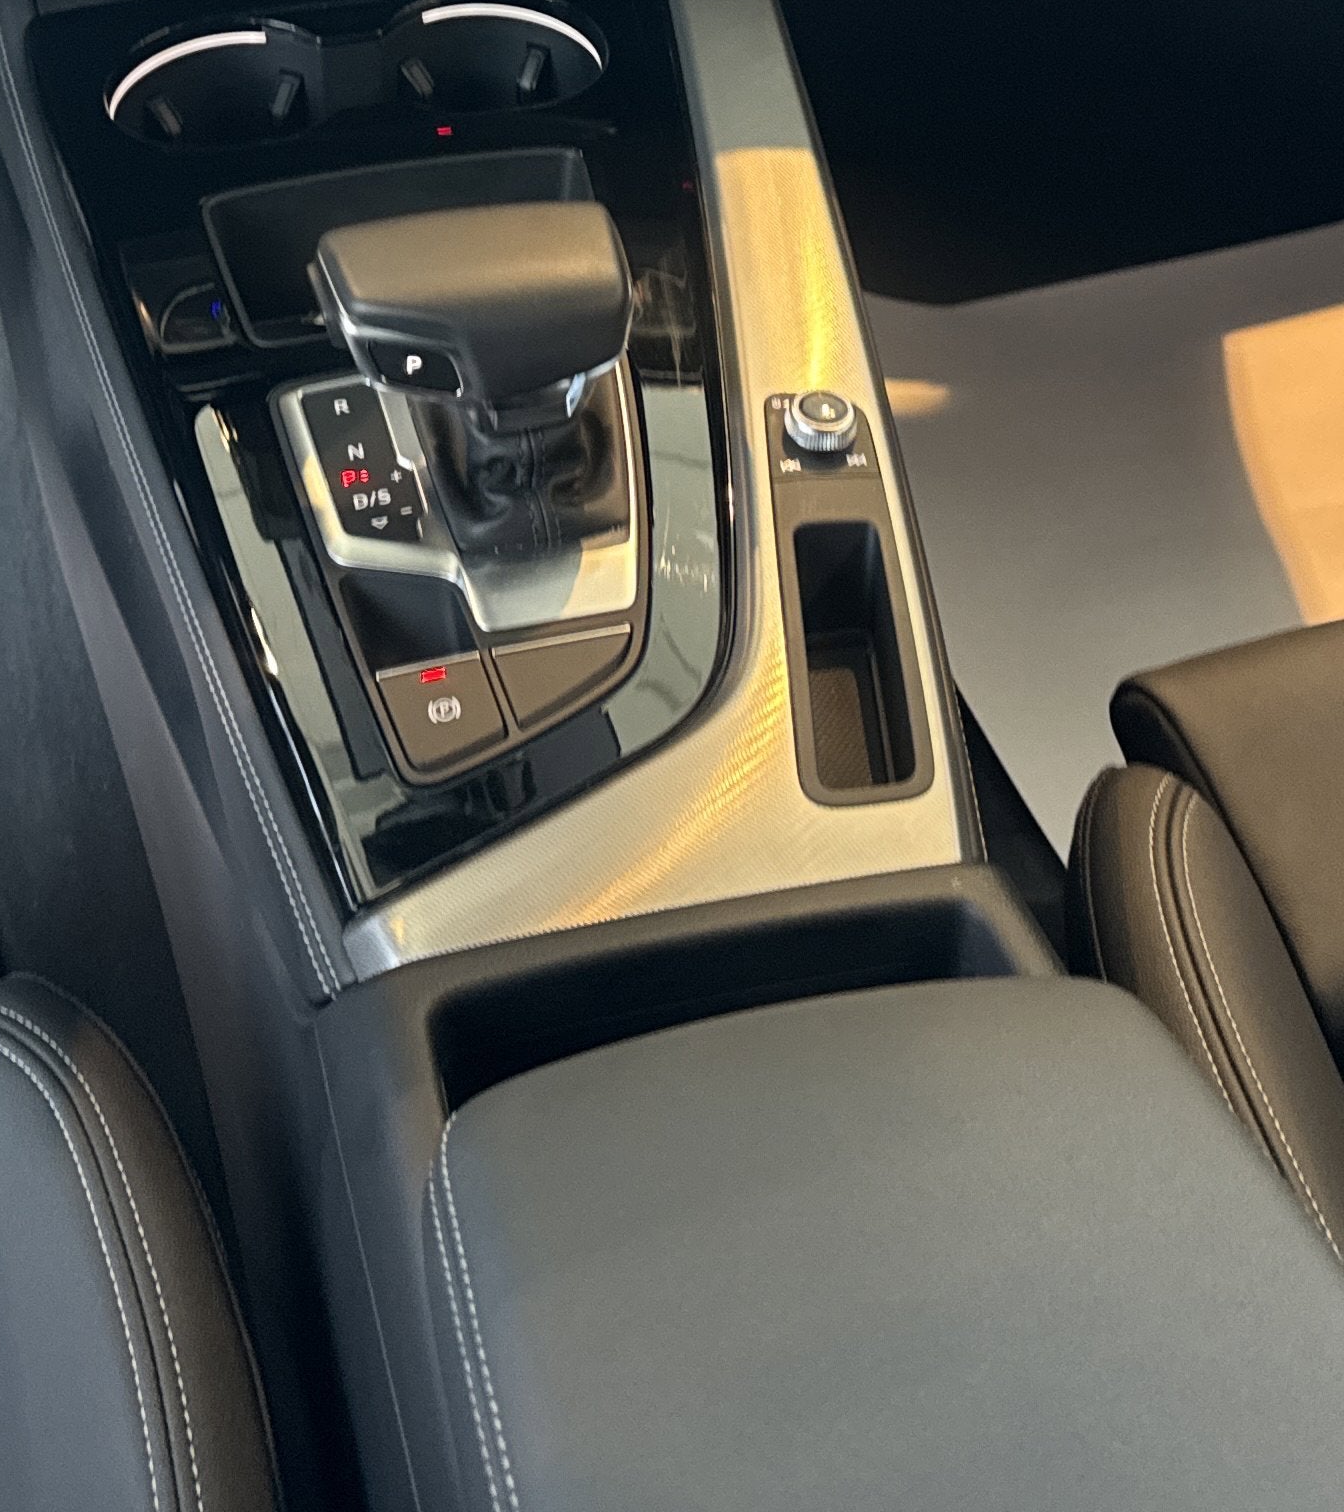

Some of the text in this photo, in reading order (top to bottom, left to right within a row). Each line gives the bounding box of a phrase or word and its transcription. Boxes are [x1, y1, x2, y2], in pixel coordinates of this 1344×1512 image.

[406, 355, 423, 376] P
[333, 398, 351, 416] R
[347, 442, 365, 462] N
[352, 487, 392, 511] D/S
